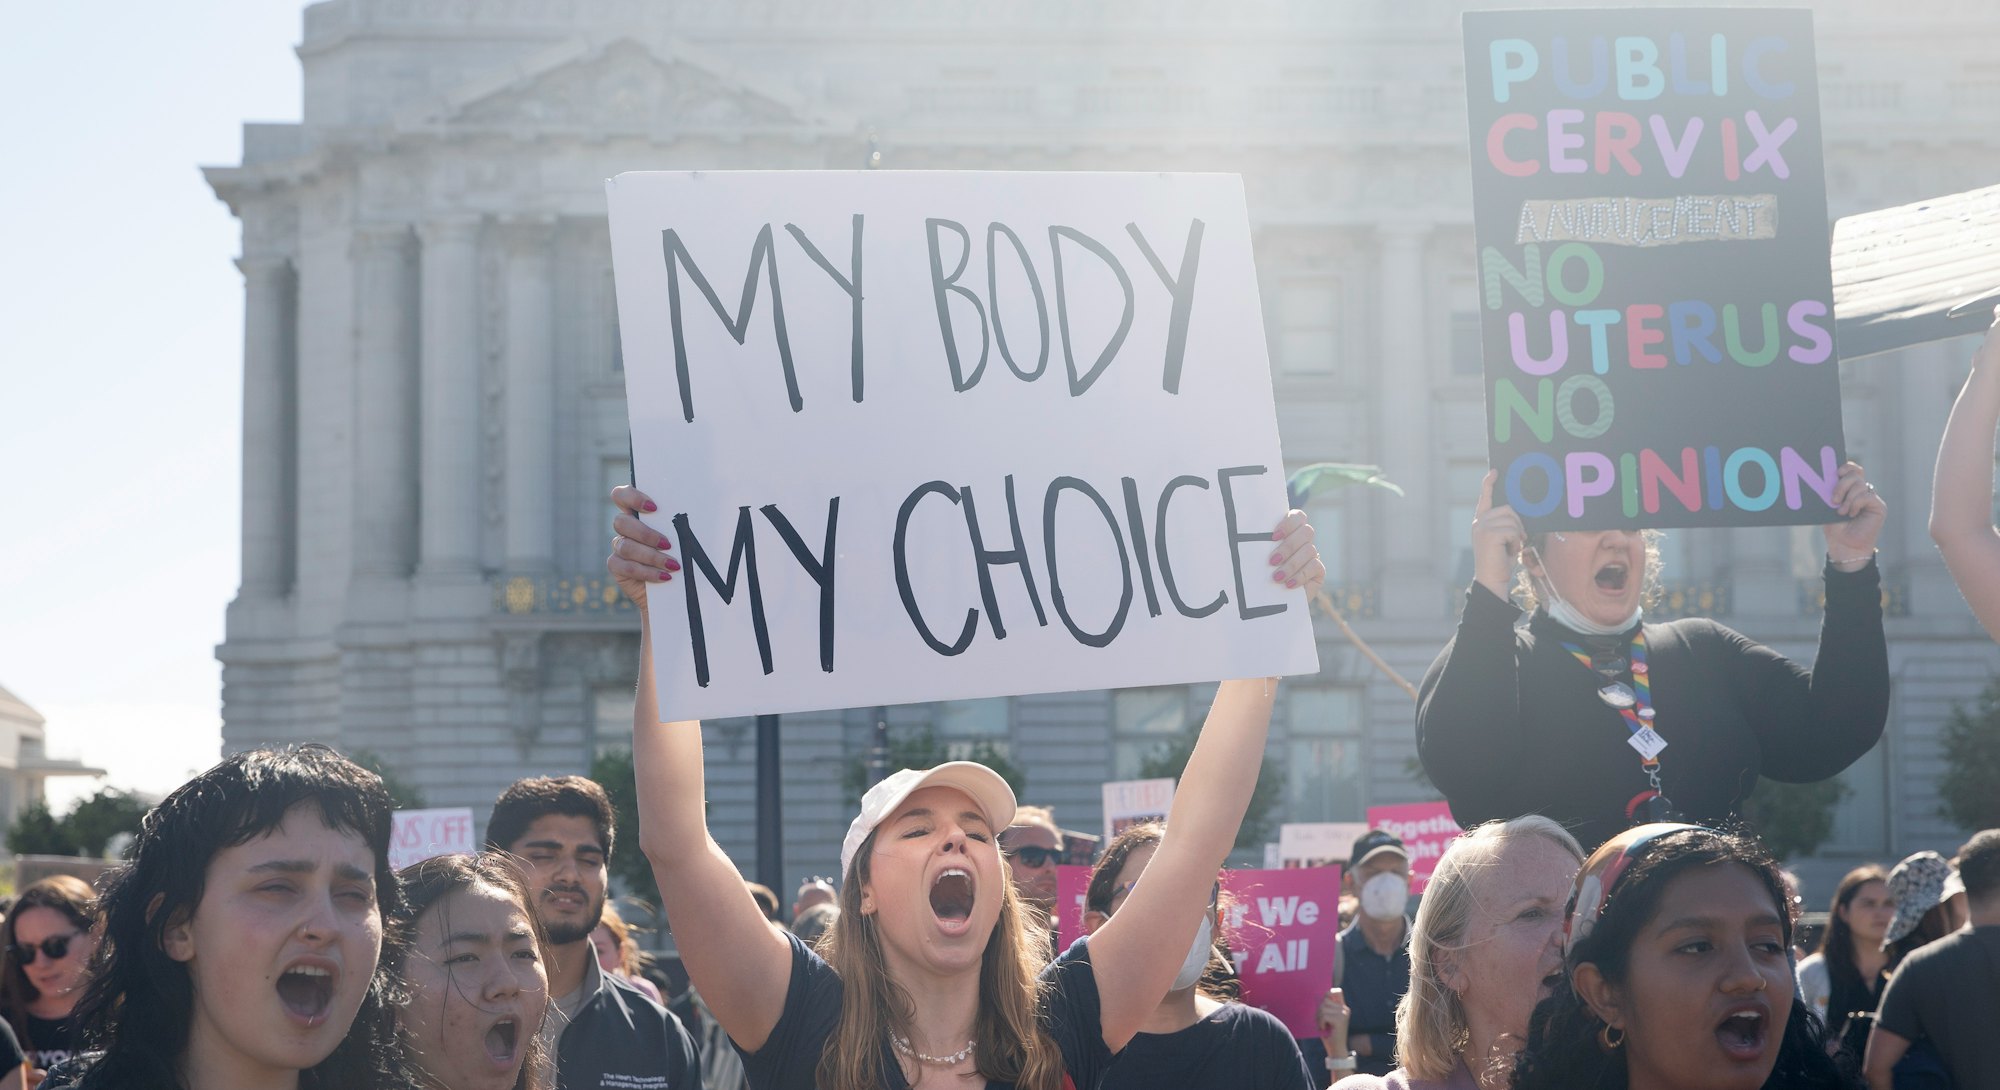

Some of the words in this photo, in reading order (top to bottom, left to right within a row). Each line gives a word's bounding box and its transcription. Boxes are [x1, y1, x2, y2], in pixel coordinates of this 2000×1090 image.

[1489, 31, 1796, 103] PUBLIC
[1486, 109, 1798, 181] CERVIX
[1482, 242, 1604, 310] NO
[661, 213, 864, 423] MY
[926, 218, 1205, 398] BODY
[1508, 300, 1833, 376] UTERUS
[1494, 374, 1614, 443] NO
[1505, 445, 1842, 518] OPINION
[672, 496, 840, 688] MY
[893, 465, 1288, 657] CHOICE
[430, 816, 470, 847] OFF
[1257, 896, 1319, 926] We
[1256, 939, 1309, 974] All
